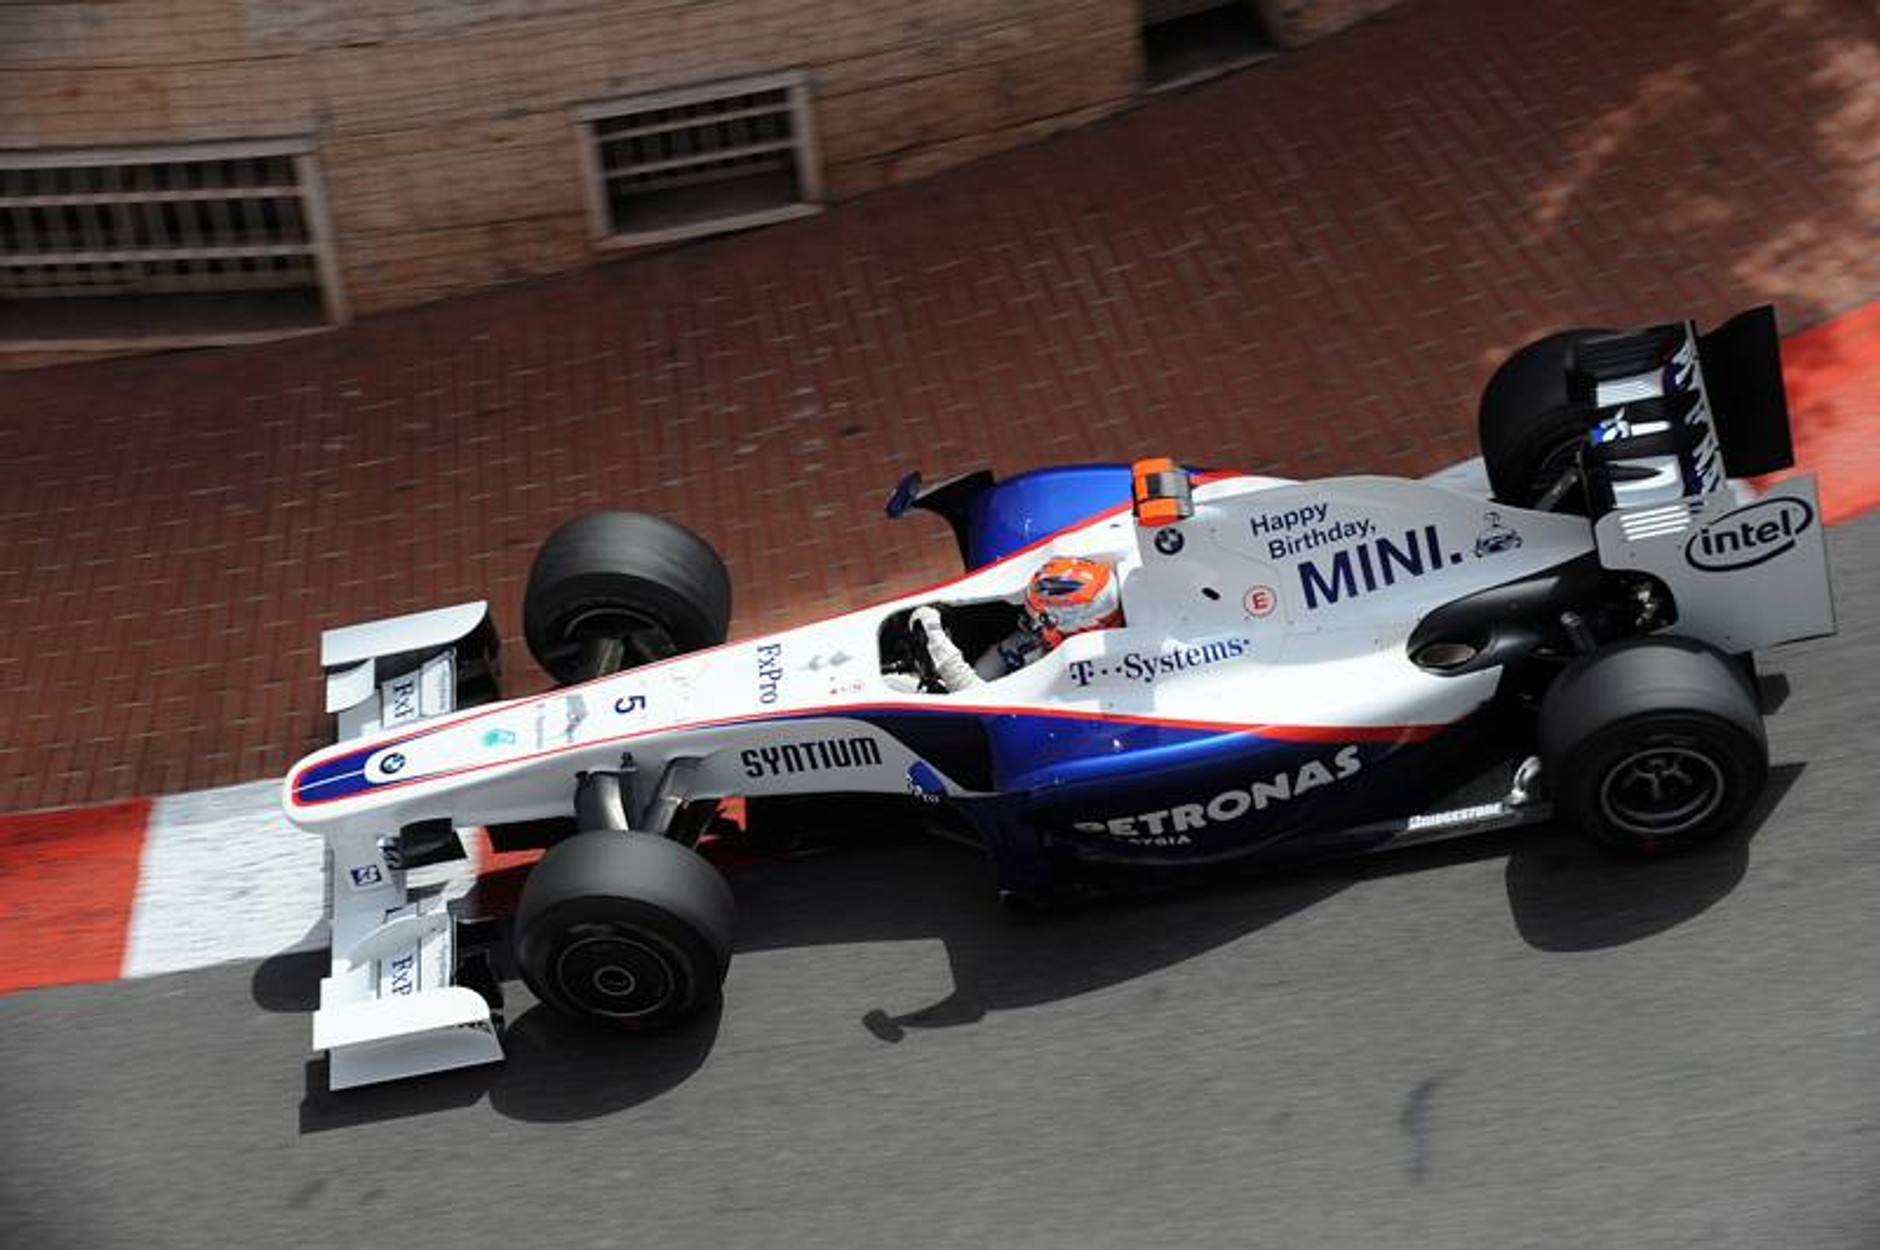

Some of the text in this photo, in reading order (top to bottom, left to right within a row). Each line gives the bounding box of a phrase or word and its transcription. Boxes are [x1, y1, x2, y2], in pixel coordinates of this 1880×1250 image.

[1250, 502, 1329, 537] Happy
[1268, 517, 1377, 560] Birthday,
[1700, 509, 1792, 555] intel
[1297, 525, 1463, 610] MINI.
[756, 642, 785, 704] FxPro
[614, 695, 646, 715] 5
[741, 737, 882, 780] SYNTIUM
